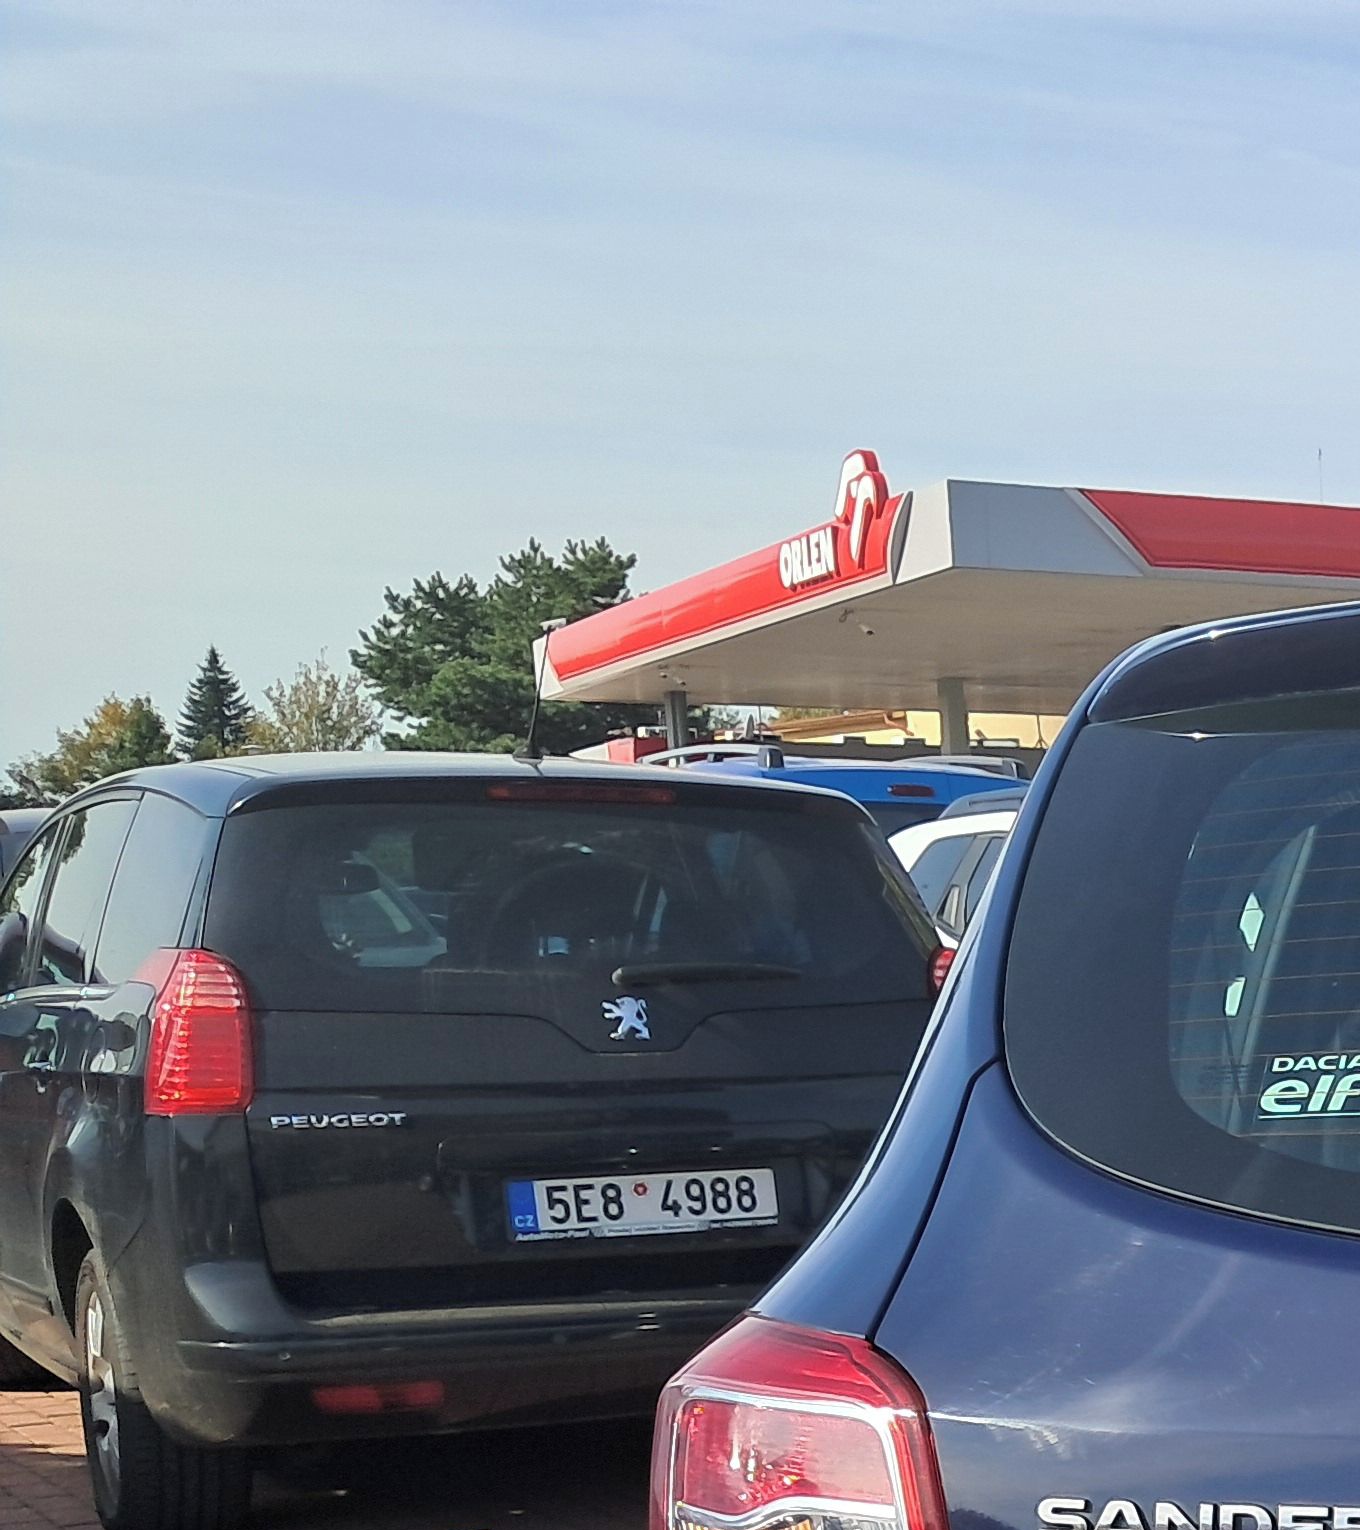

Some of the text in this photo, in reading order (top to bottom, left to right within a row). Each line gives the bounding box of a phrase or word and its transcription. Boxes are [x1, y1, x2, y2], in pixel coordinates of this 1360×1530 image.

[779, 526, 835, 588] ORLEN
[270, 1112, 406, 1129] PEUGEOT
[514, 1175, 758, 1228] CZ 5E8 4988
